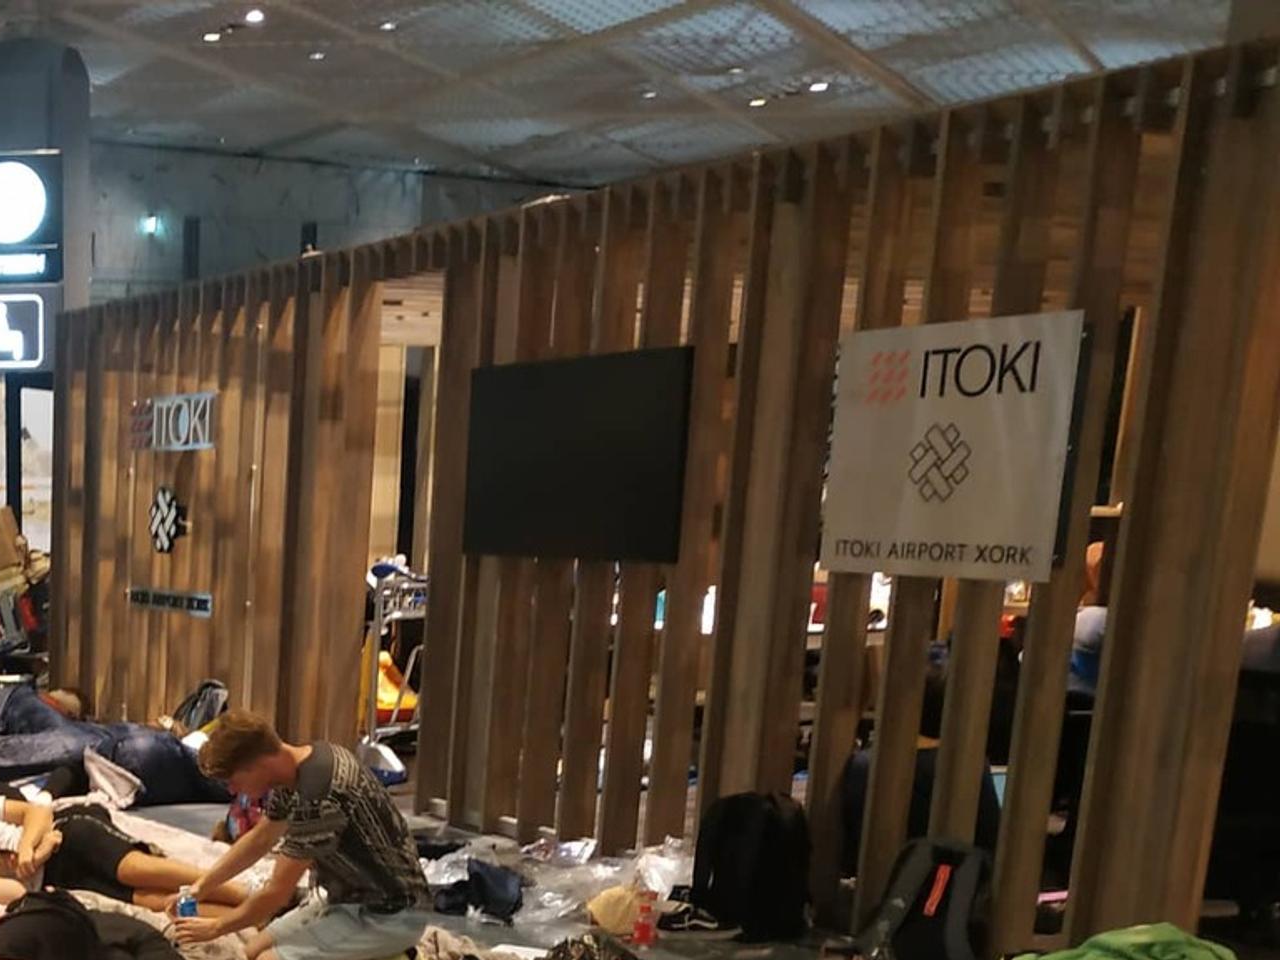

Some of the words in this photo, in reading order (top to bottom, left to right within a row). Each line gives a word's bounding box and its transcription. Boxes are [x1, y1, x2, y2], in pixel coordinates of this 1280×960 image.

[921, 342, 1041, 398] ITOKI
[152, 398, 211, 446] ITOKI
[835, 539, 880, 559] ITOKI
[887, 543, 967, 562] AIRPORT
[975, 545, 1032, 566] XORK
